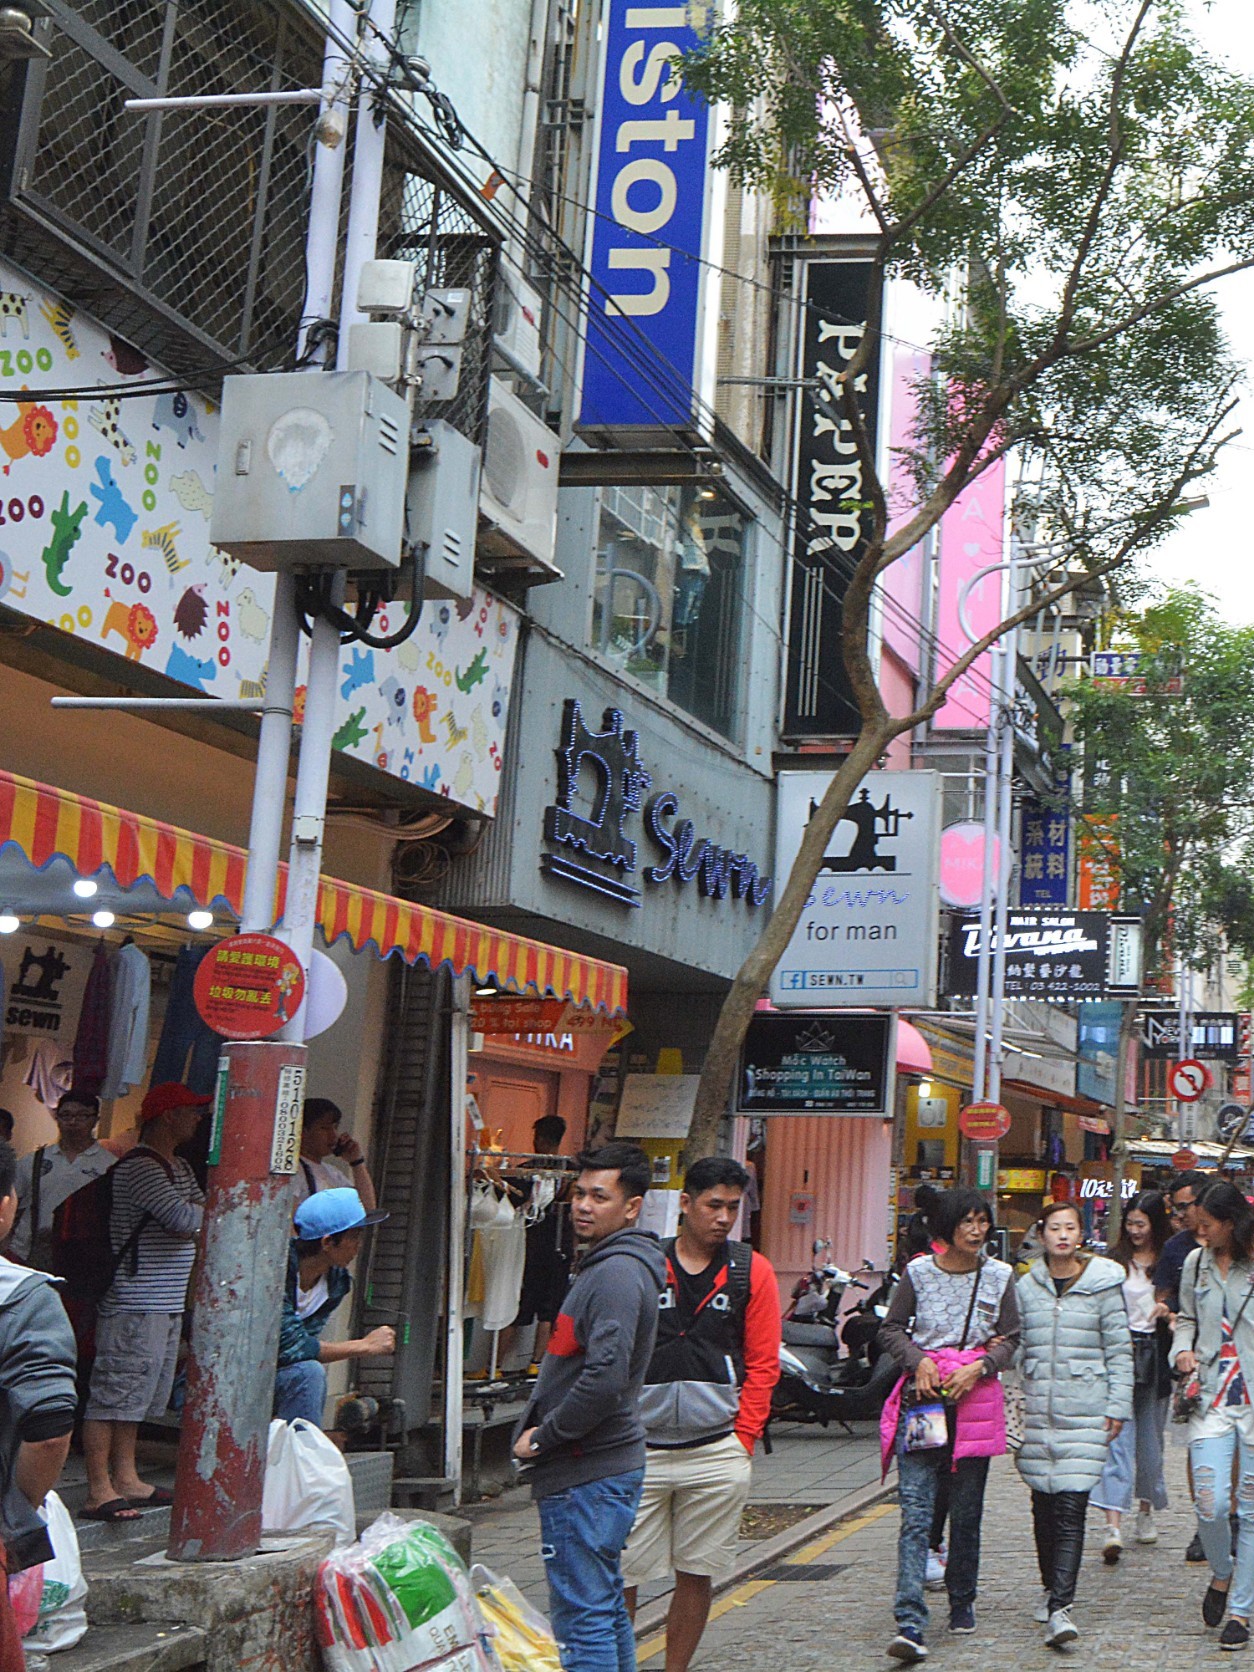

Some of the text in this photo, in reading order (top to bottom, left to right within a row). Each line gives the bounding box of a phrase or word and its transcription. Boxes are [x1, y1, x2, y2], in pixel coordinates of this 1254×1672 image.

[0, 347, 52, 377] ZOO
[142, 440, 162, 512] ZOO
[105, 553, 151, 593] ZOO
[216, 600, 230, 667] ZOO
[425, 651, 452, 687] ZOO
[644, 790, 774, 907] Sewn
[806, 920, 898, 941] for man
[810, 974, 865, 987] SEWN.TW
[6, 1006, 61, 1031] sewn
[755, 1068, 810, 1083] Shopping
